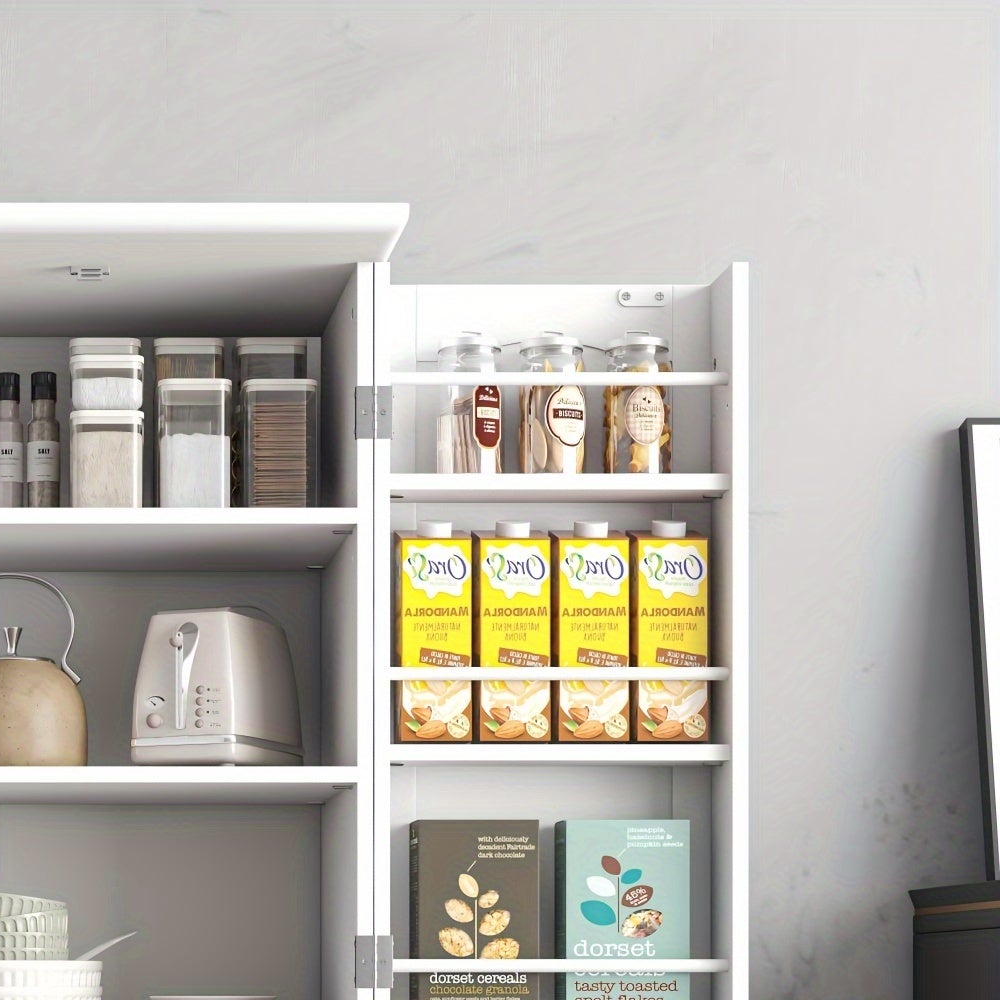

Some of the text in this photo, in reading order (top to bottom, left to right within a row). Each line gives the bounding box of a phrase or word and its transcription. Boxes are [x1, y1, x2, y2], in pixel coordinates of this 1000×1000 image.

[573, 940, 656, 957] dorset
[429, 972, 527, 984] dorset cereals
[429, 985, 530, 996] chocolate granola
[574, 980, 678, 993] tasty toasted
